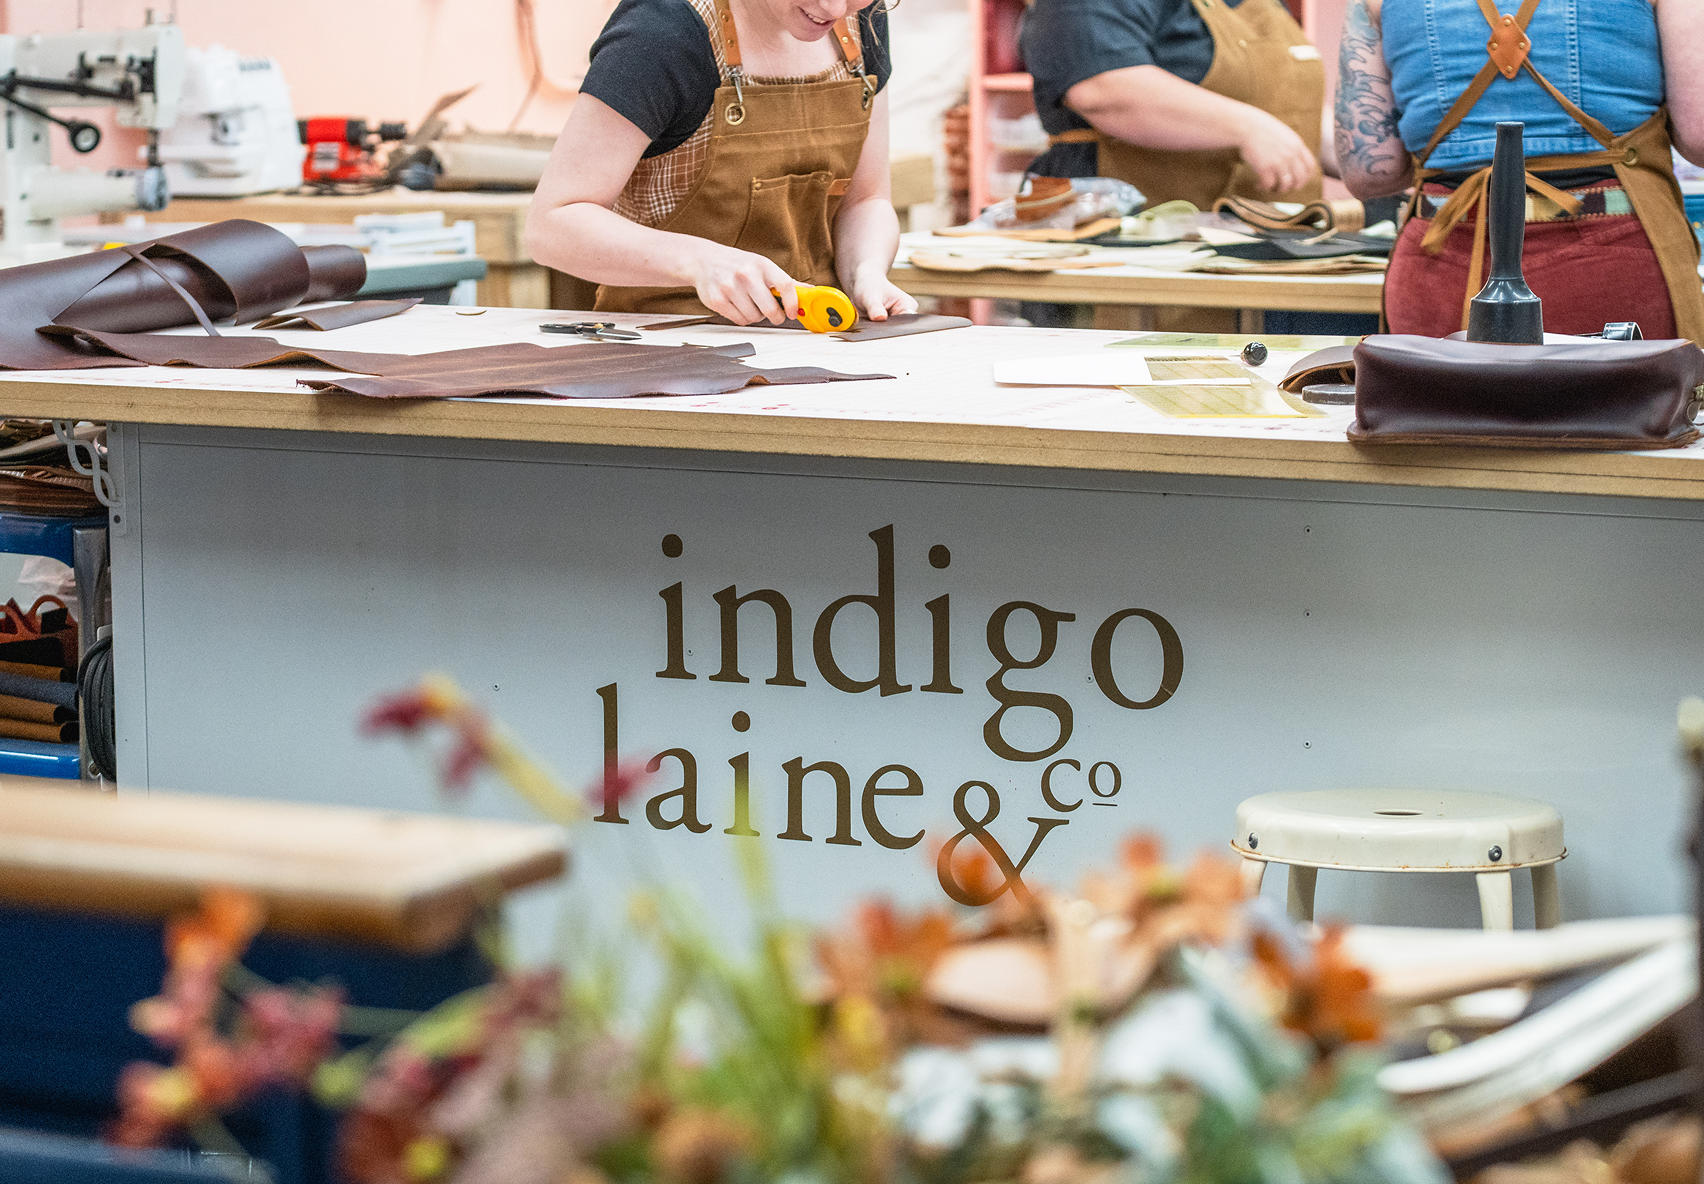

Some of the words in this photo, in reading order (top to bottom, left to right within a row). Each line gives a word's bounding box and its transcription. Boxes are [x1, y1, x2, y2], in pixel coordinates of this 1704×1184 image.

[655, 523, 1184, 762] indigo
[593, 682, 926, 850] laine
[937, 780, 1070, 906] &
